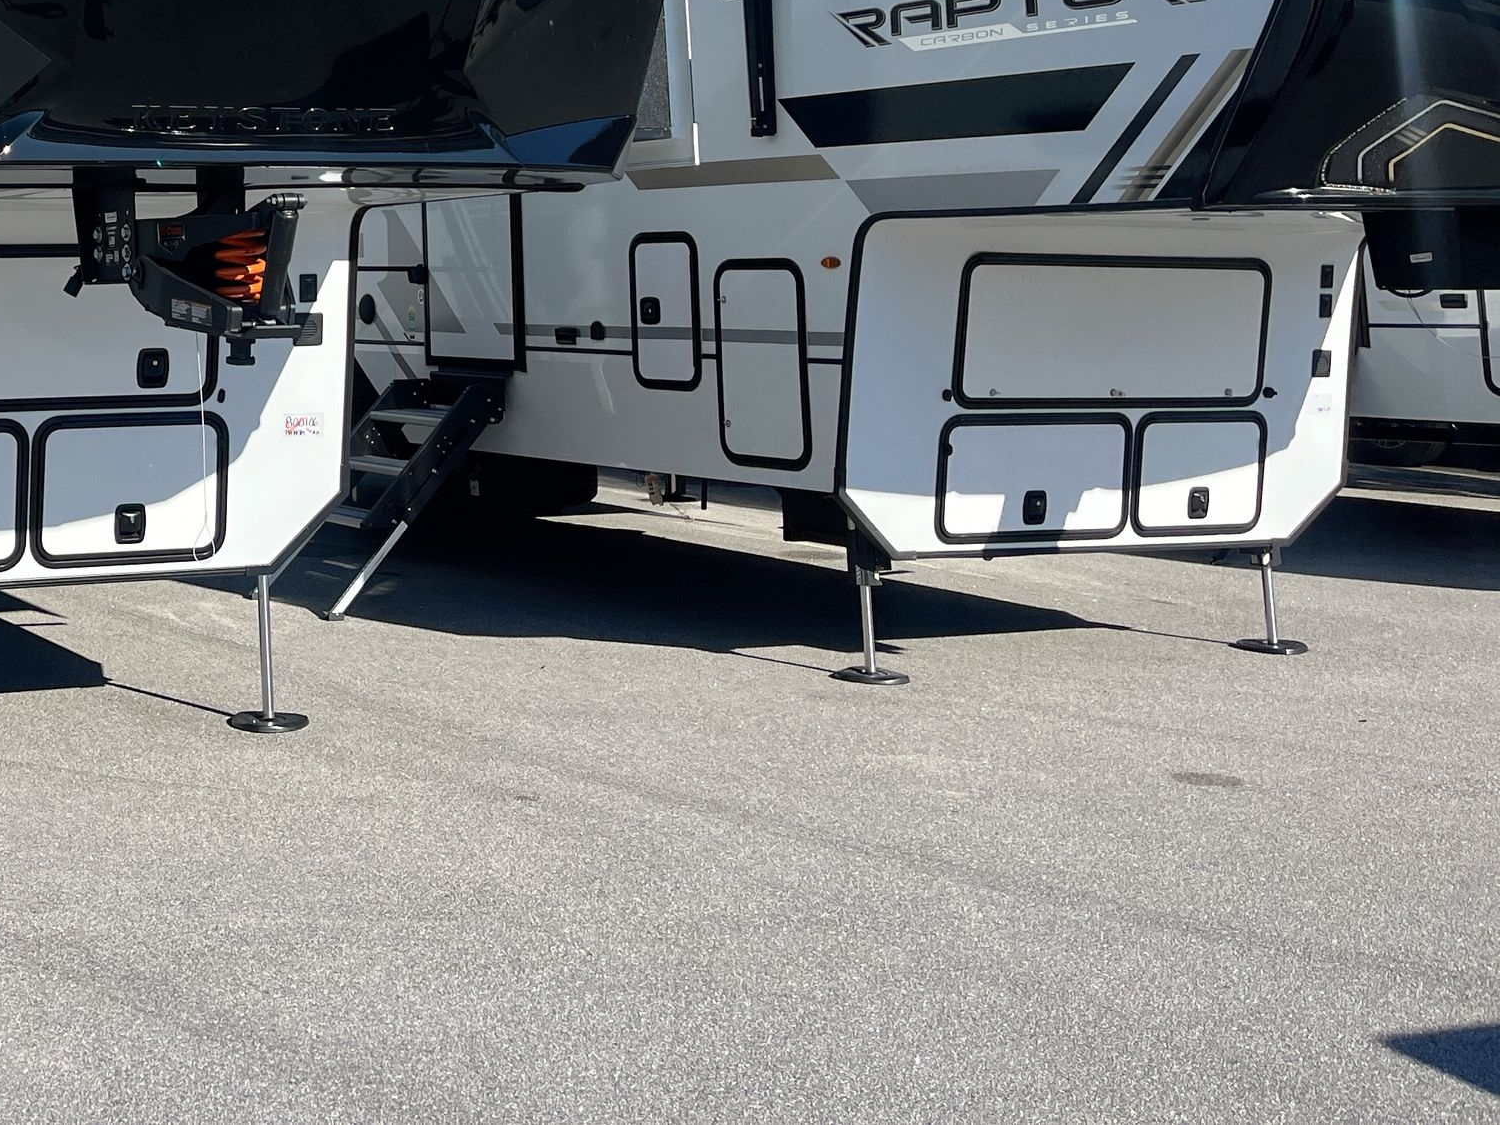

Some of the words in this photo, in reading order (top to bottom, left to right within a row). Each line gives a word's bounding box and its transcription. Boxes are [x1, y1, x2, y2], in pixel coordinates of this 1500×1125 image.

[919, 28, 1004, 47] CARBON
[1026, 11, 1130, 32] SERIES
[130, 104, 397, 131] KEYSTONE
